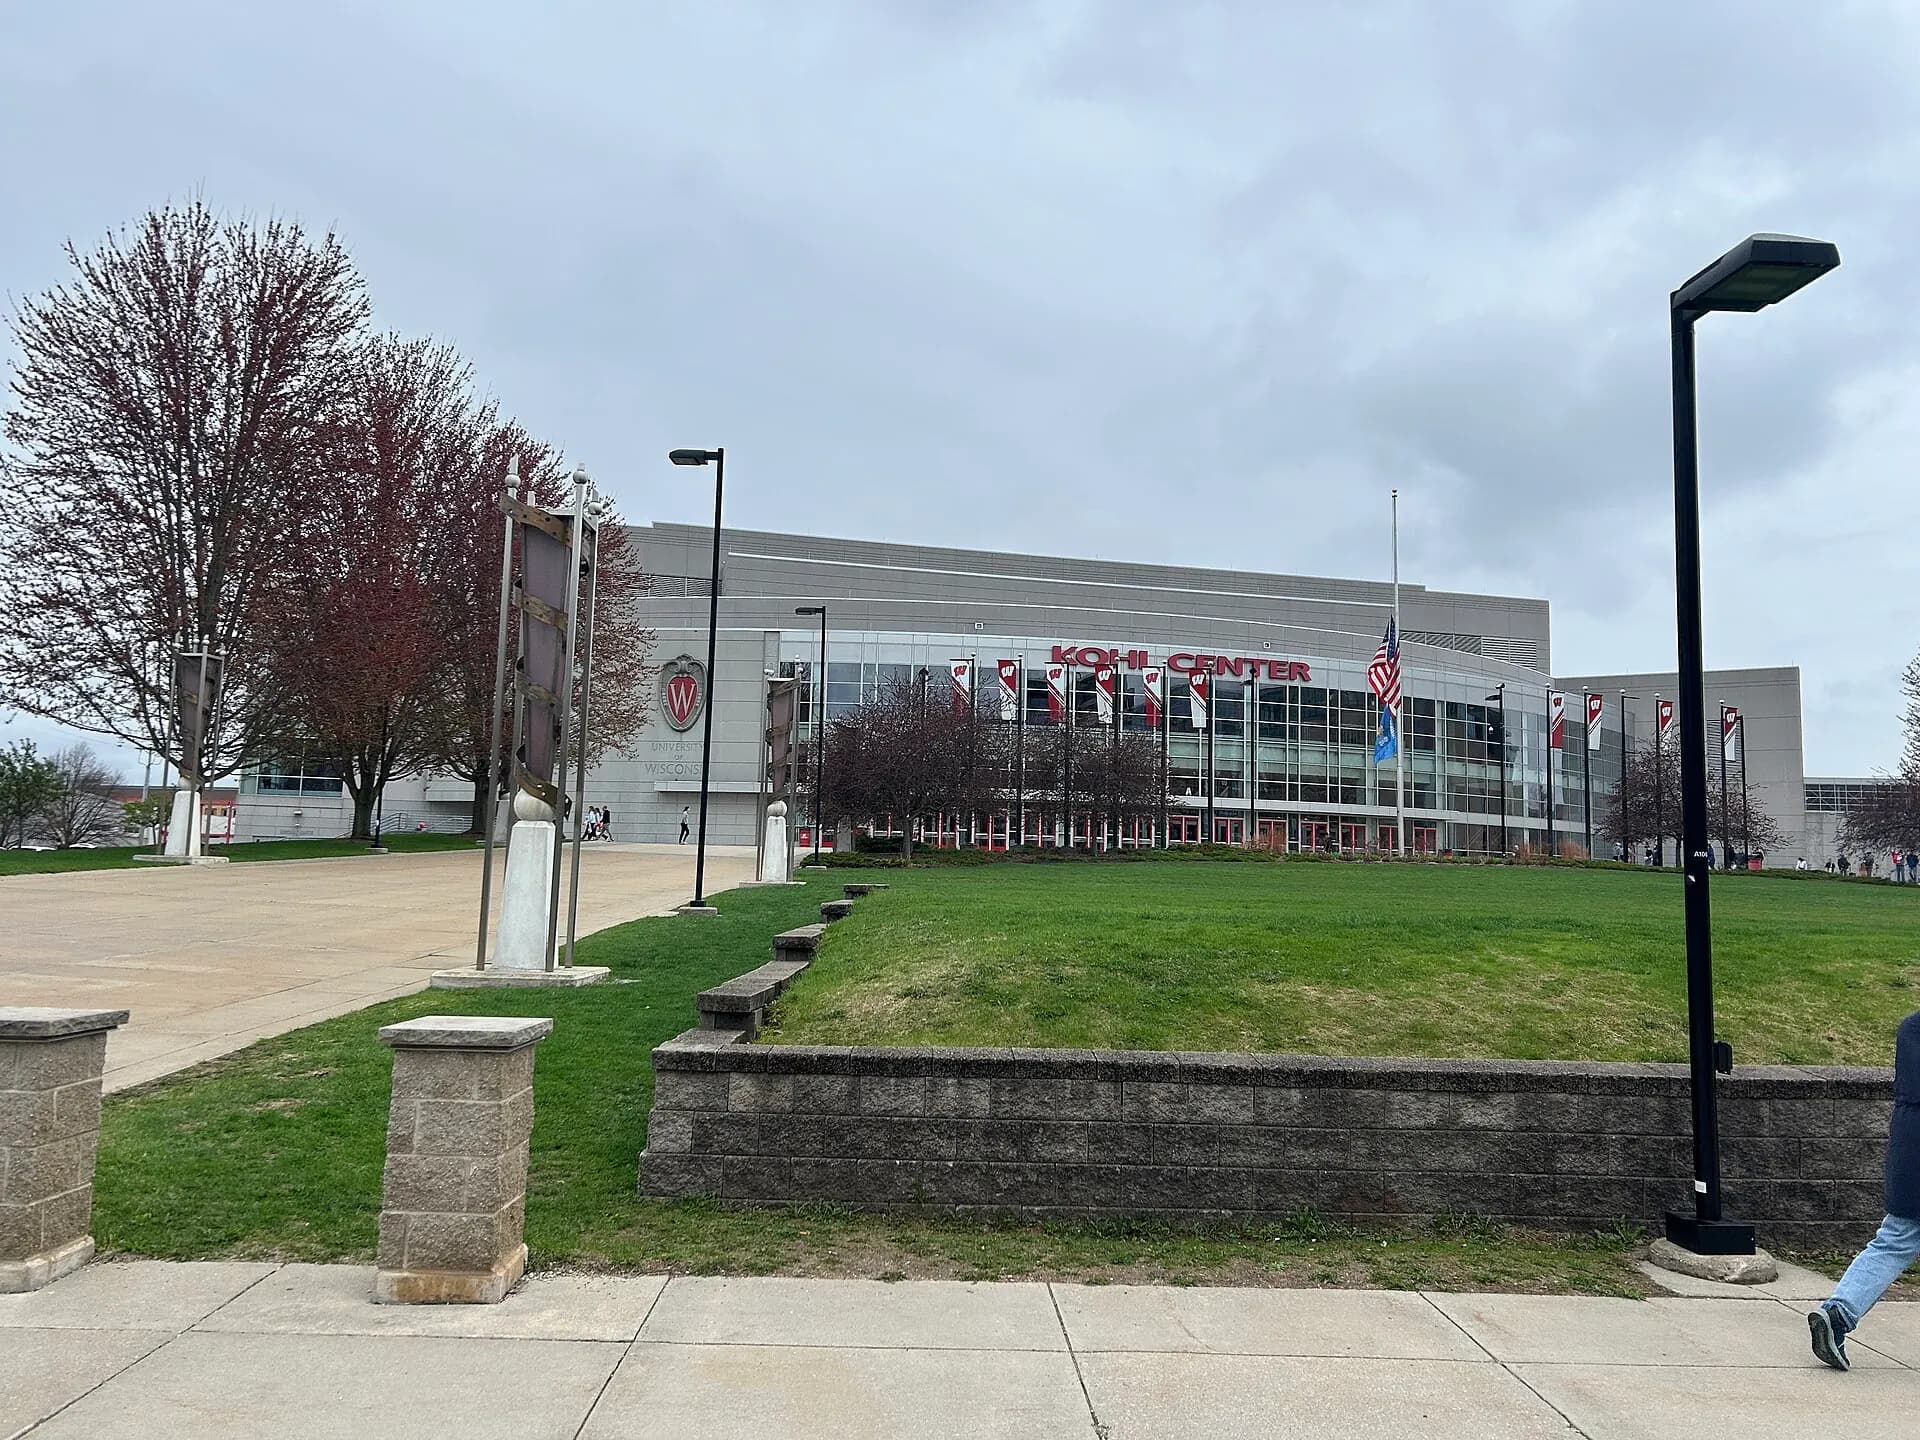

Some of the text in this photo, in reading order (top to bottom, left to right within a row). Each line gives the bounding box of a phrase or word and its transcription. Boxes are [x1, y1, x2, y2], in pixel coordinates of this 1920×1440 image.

[954, 665, 968, 678] W
[1001, 665, 1015, 678] W
[1167, 653, 1312, 682] CENTER
[1048, 668, 1063, 681] W
[1097, 670, 1112, 682] W
[1145, 672, 1159, 685] W
[1191, 673, 1205, 686] W
[669, 682, 697, 717] W
[1552, 697, 1563, 708] W
[1590, 700, 1601, 711] W
[1661, 706, 1672, 717] W
[1726, 712, 1736, 723] W
[644, 763, 703, 775] WISCONSI
